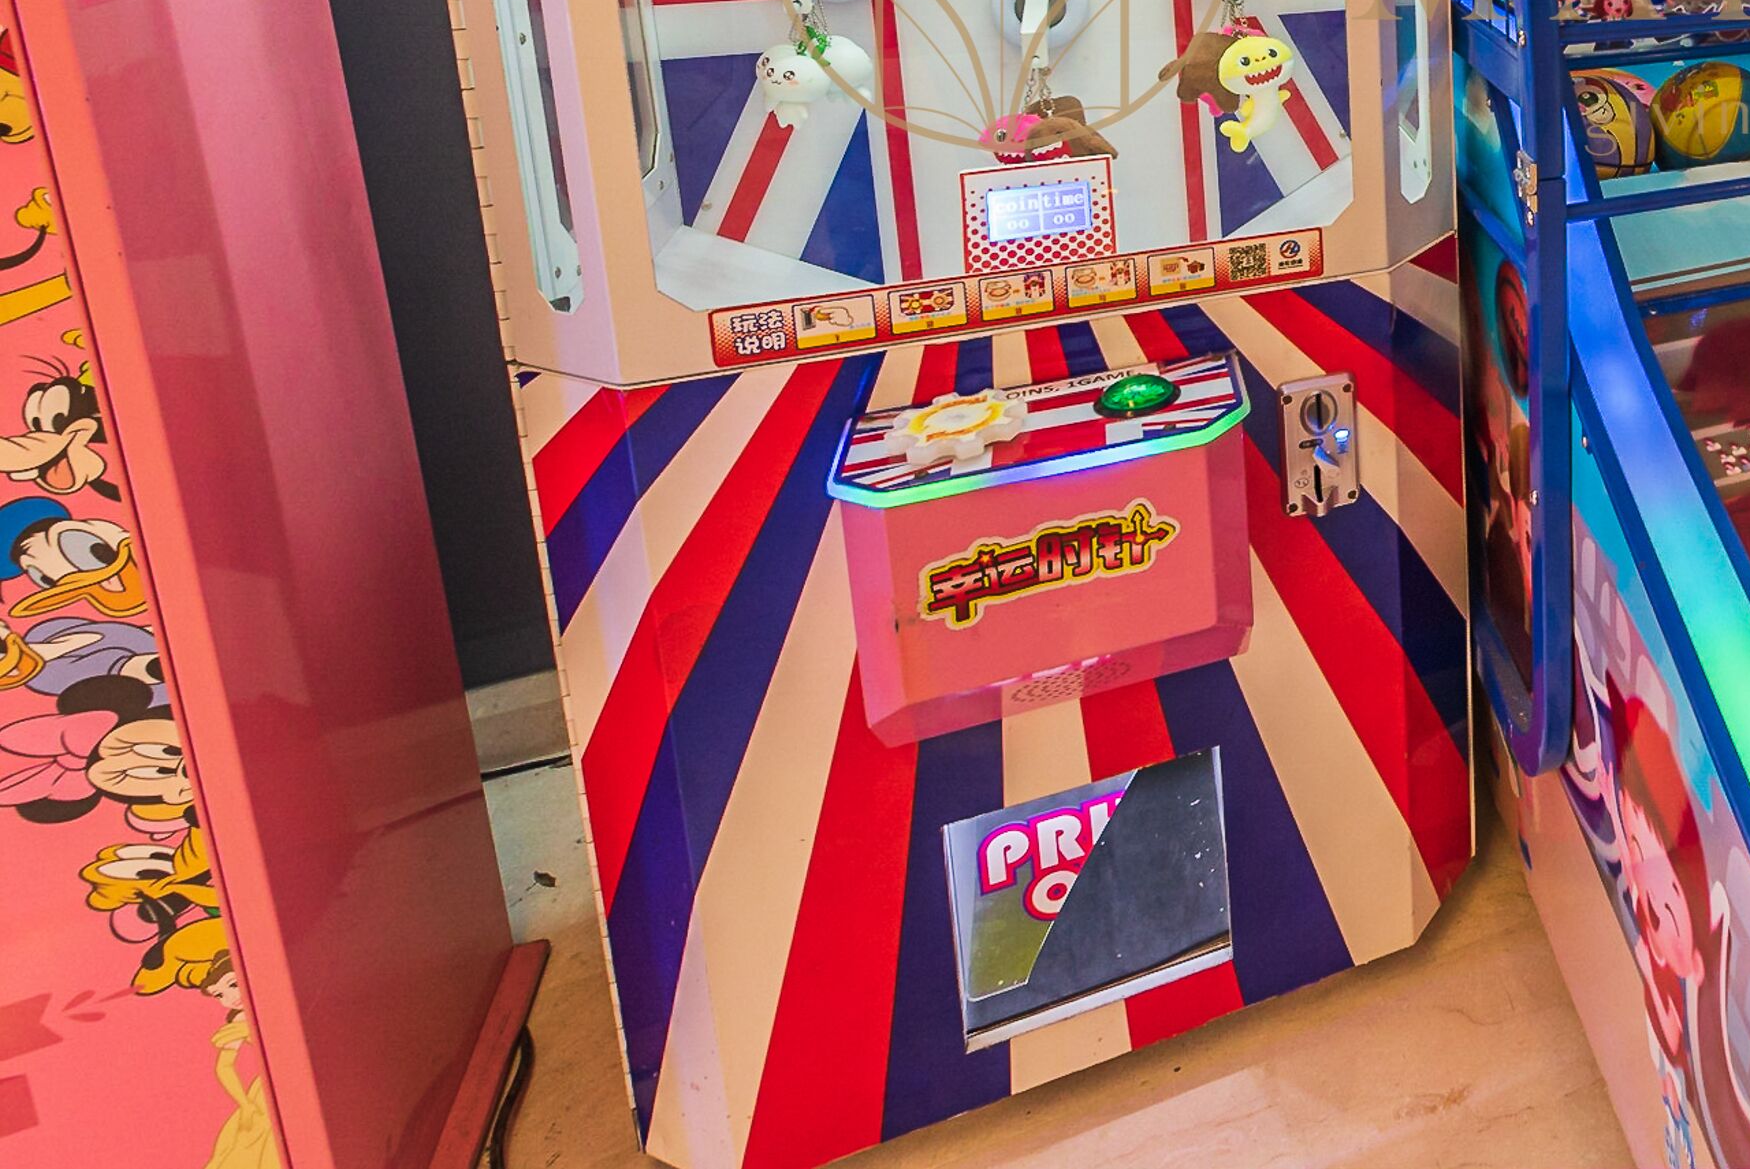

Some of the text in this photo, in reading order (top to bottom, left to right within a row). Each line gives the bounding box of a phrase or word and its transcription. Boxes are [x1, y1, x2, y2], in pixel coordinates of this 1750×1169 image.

[1043, 192, 1085, 209] time
[731, 310, 784, 334] 玩法
[735, 332, 787, 355] 说明
[986, 797, 1123, 886] PRI
